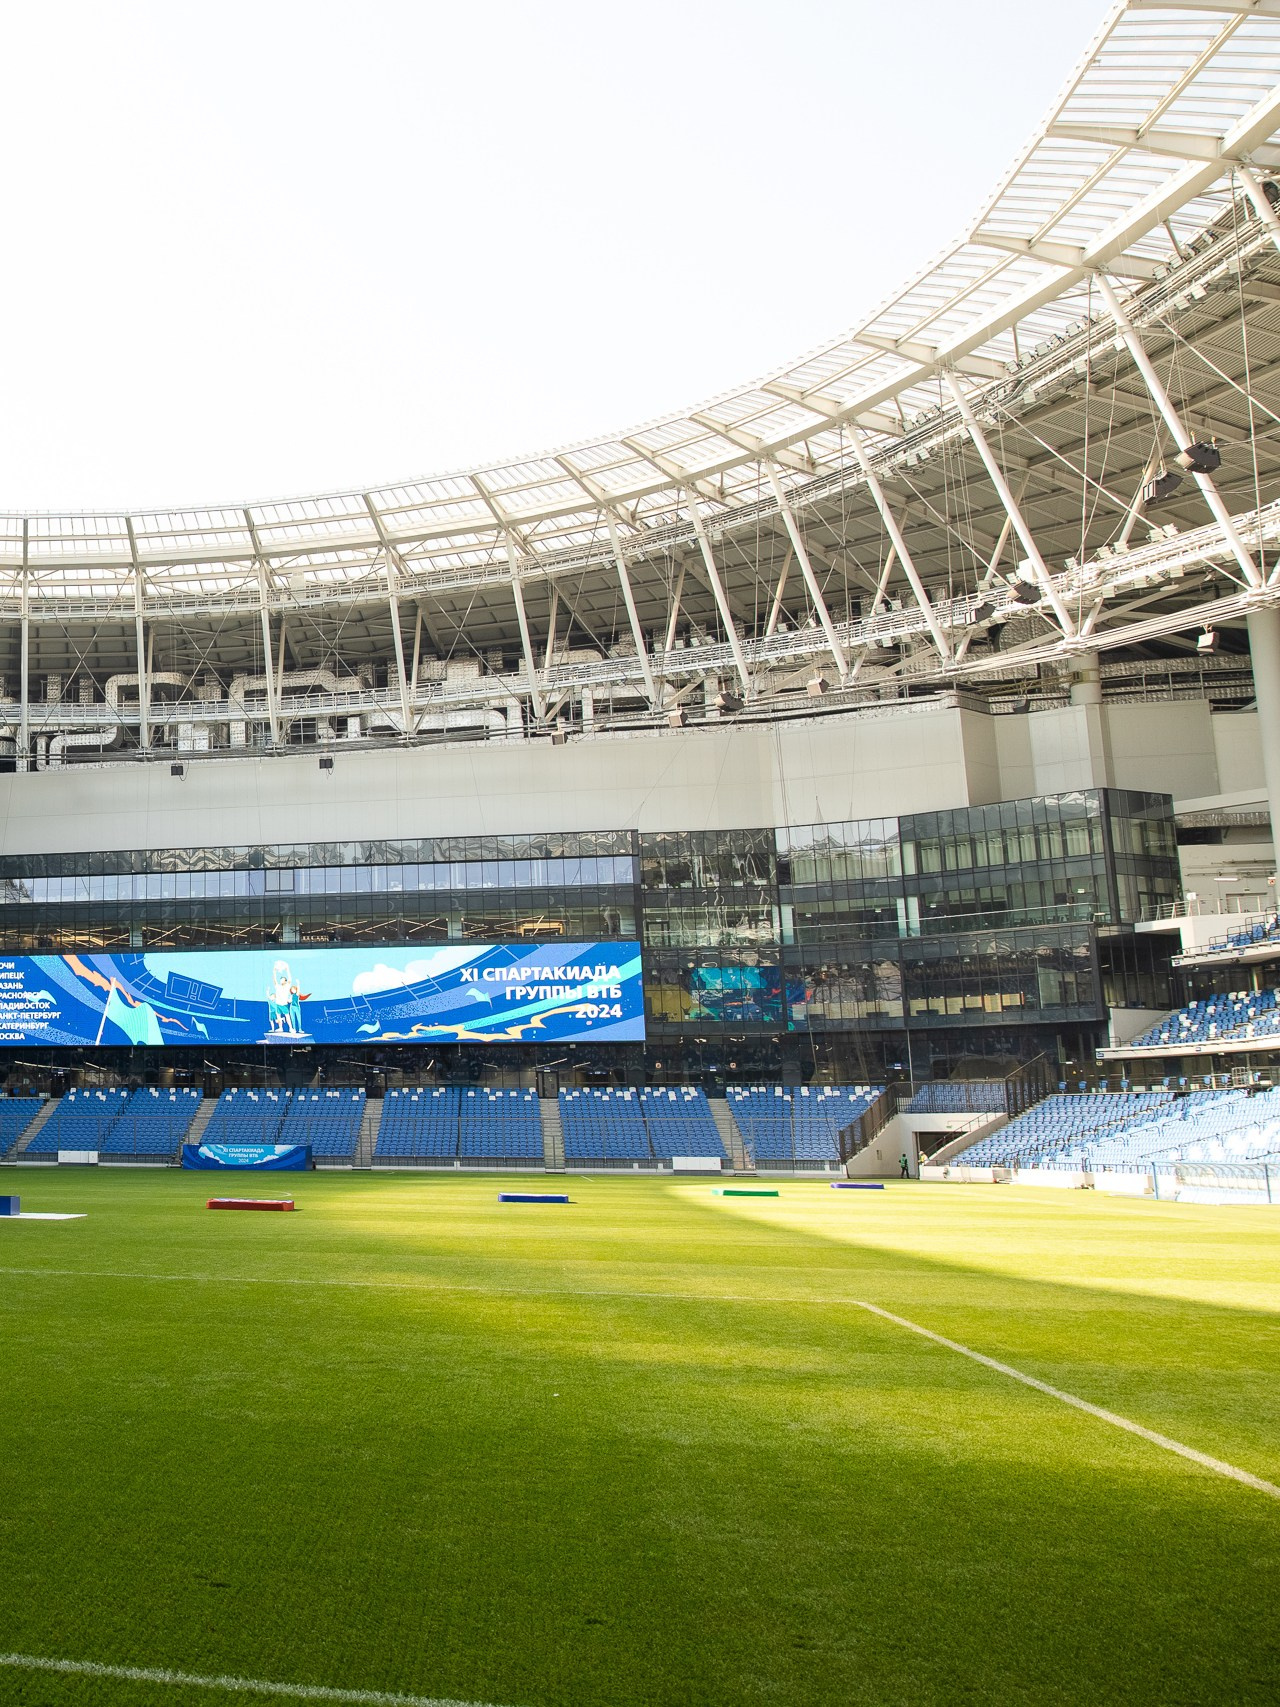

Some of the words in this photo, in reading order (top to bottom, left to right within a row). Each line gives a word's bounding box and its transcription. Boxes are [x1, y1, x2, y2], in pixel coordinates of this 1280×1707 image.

[482, 965, 621, 982] СПАРТАКИАДА
[505, 986, 582, 1000] ГРУППЫ
[586, 985, 622, 999] ВТБ
[575, 1004, 622, 1019] 2024
